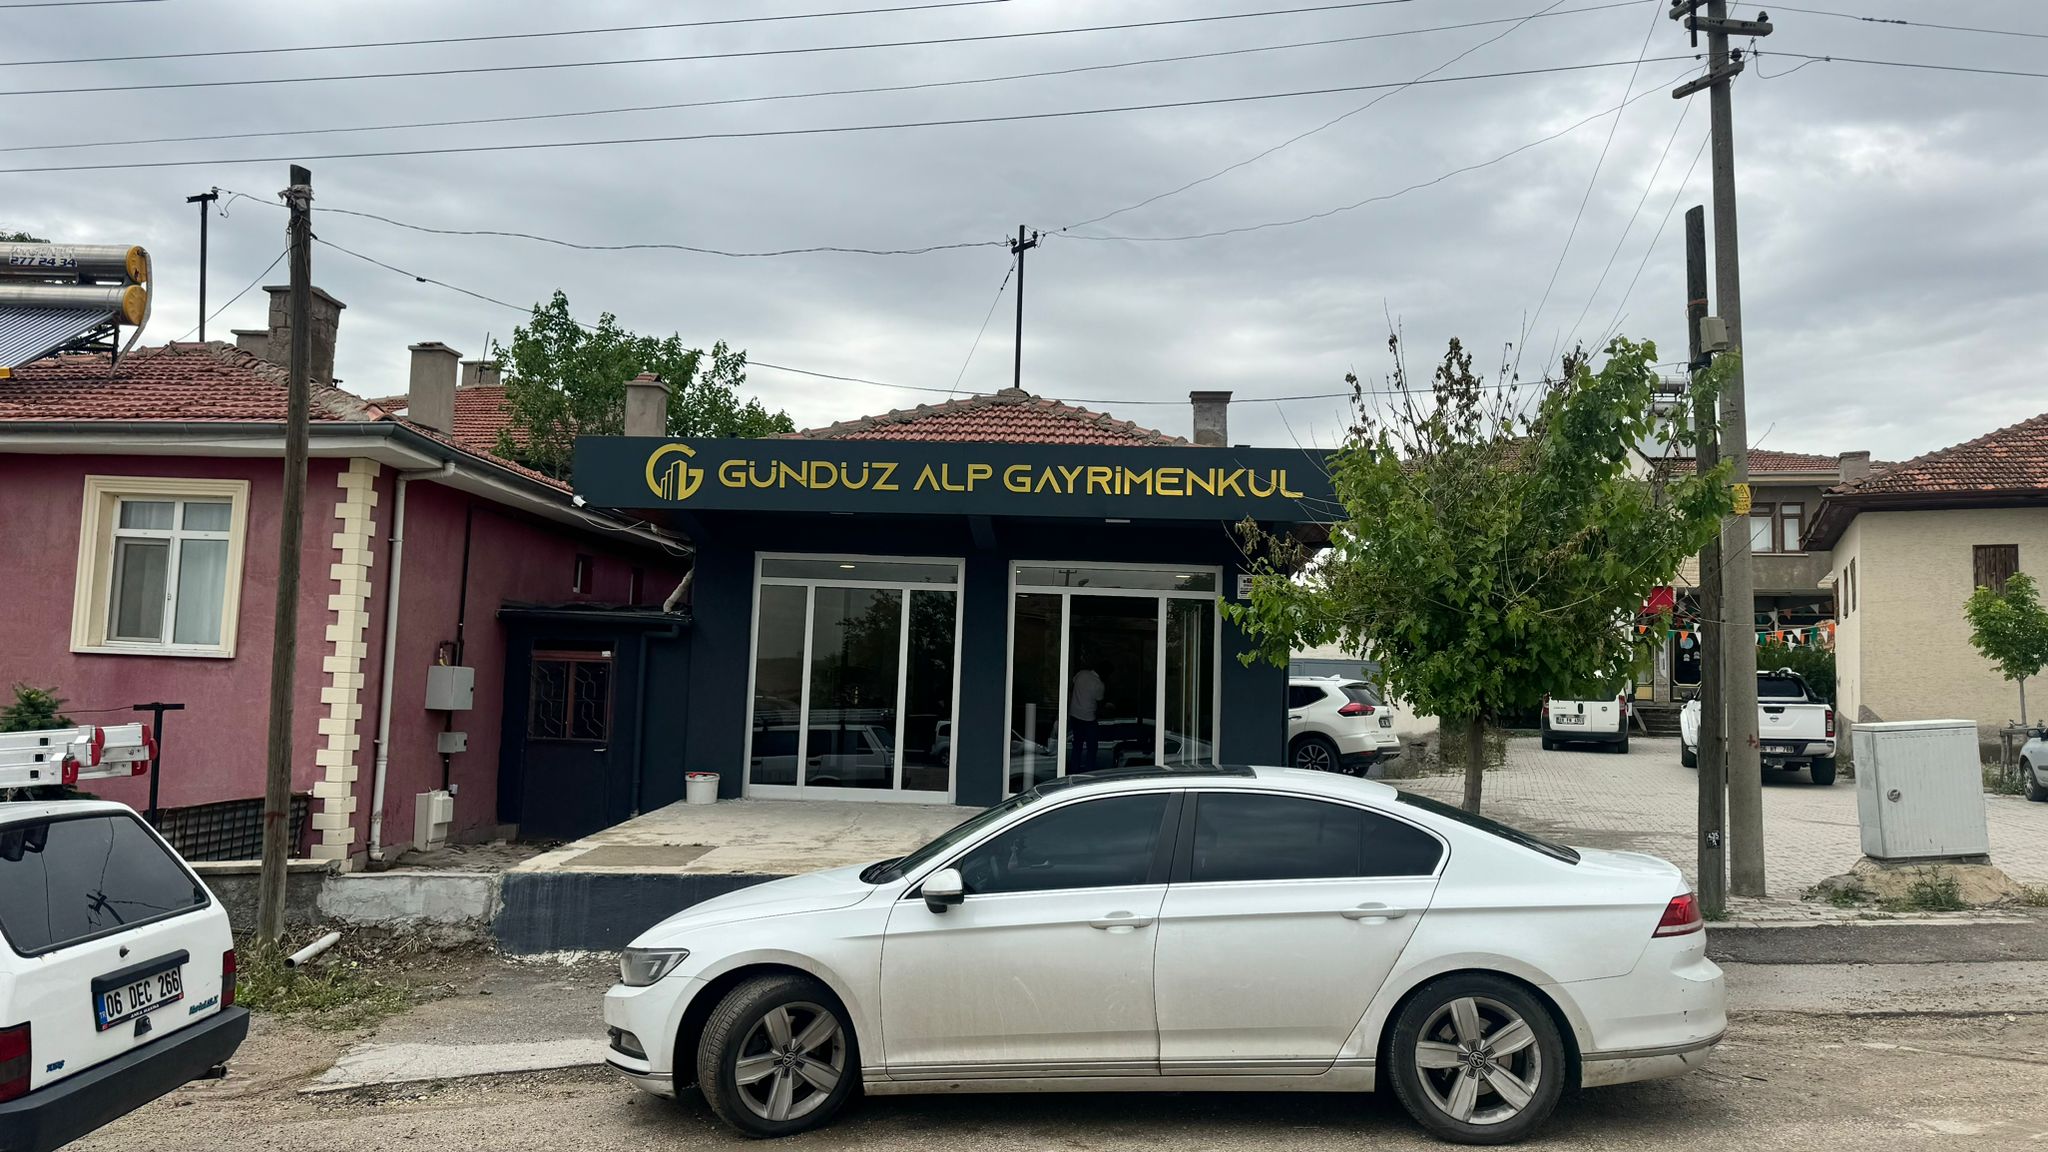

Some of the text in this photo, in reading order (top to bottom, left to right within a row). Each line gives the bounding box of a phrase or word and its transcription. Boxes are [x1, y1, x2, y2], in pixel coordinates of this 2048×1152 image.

[10, 256, 76, 267] 277 24 34
[718, 459, 1304, 498] GÜNDÜZ ALP GAYRİMENKUL
[106, 970, 180, 1018] 06 DEC 266
